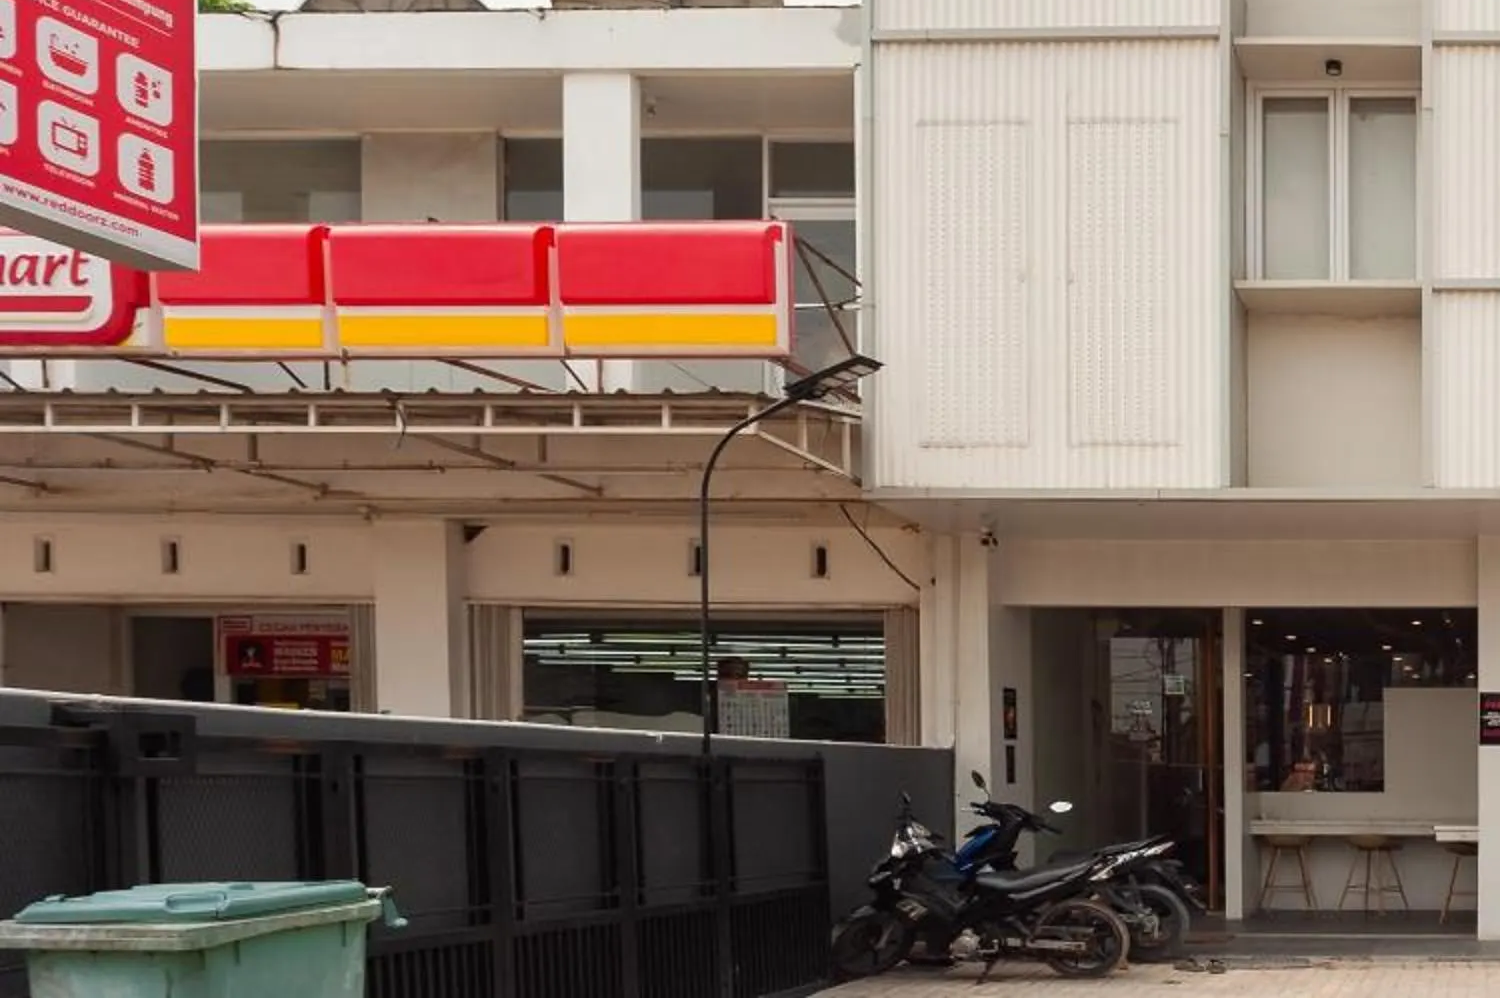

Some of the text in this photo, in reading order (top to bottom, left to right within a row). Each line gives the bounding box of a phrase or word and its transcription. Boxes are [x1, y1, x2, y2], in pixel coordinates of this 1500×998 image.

[62, 5, 141, 48] GUARANTEE
[2, 183, 141, 238] www.reddoorz.com
[0, 250, 90, 287] art
